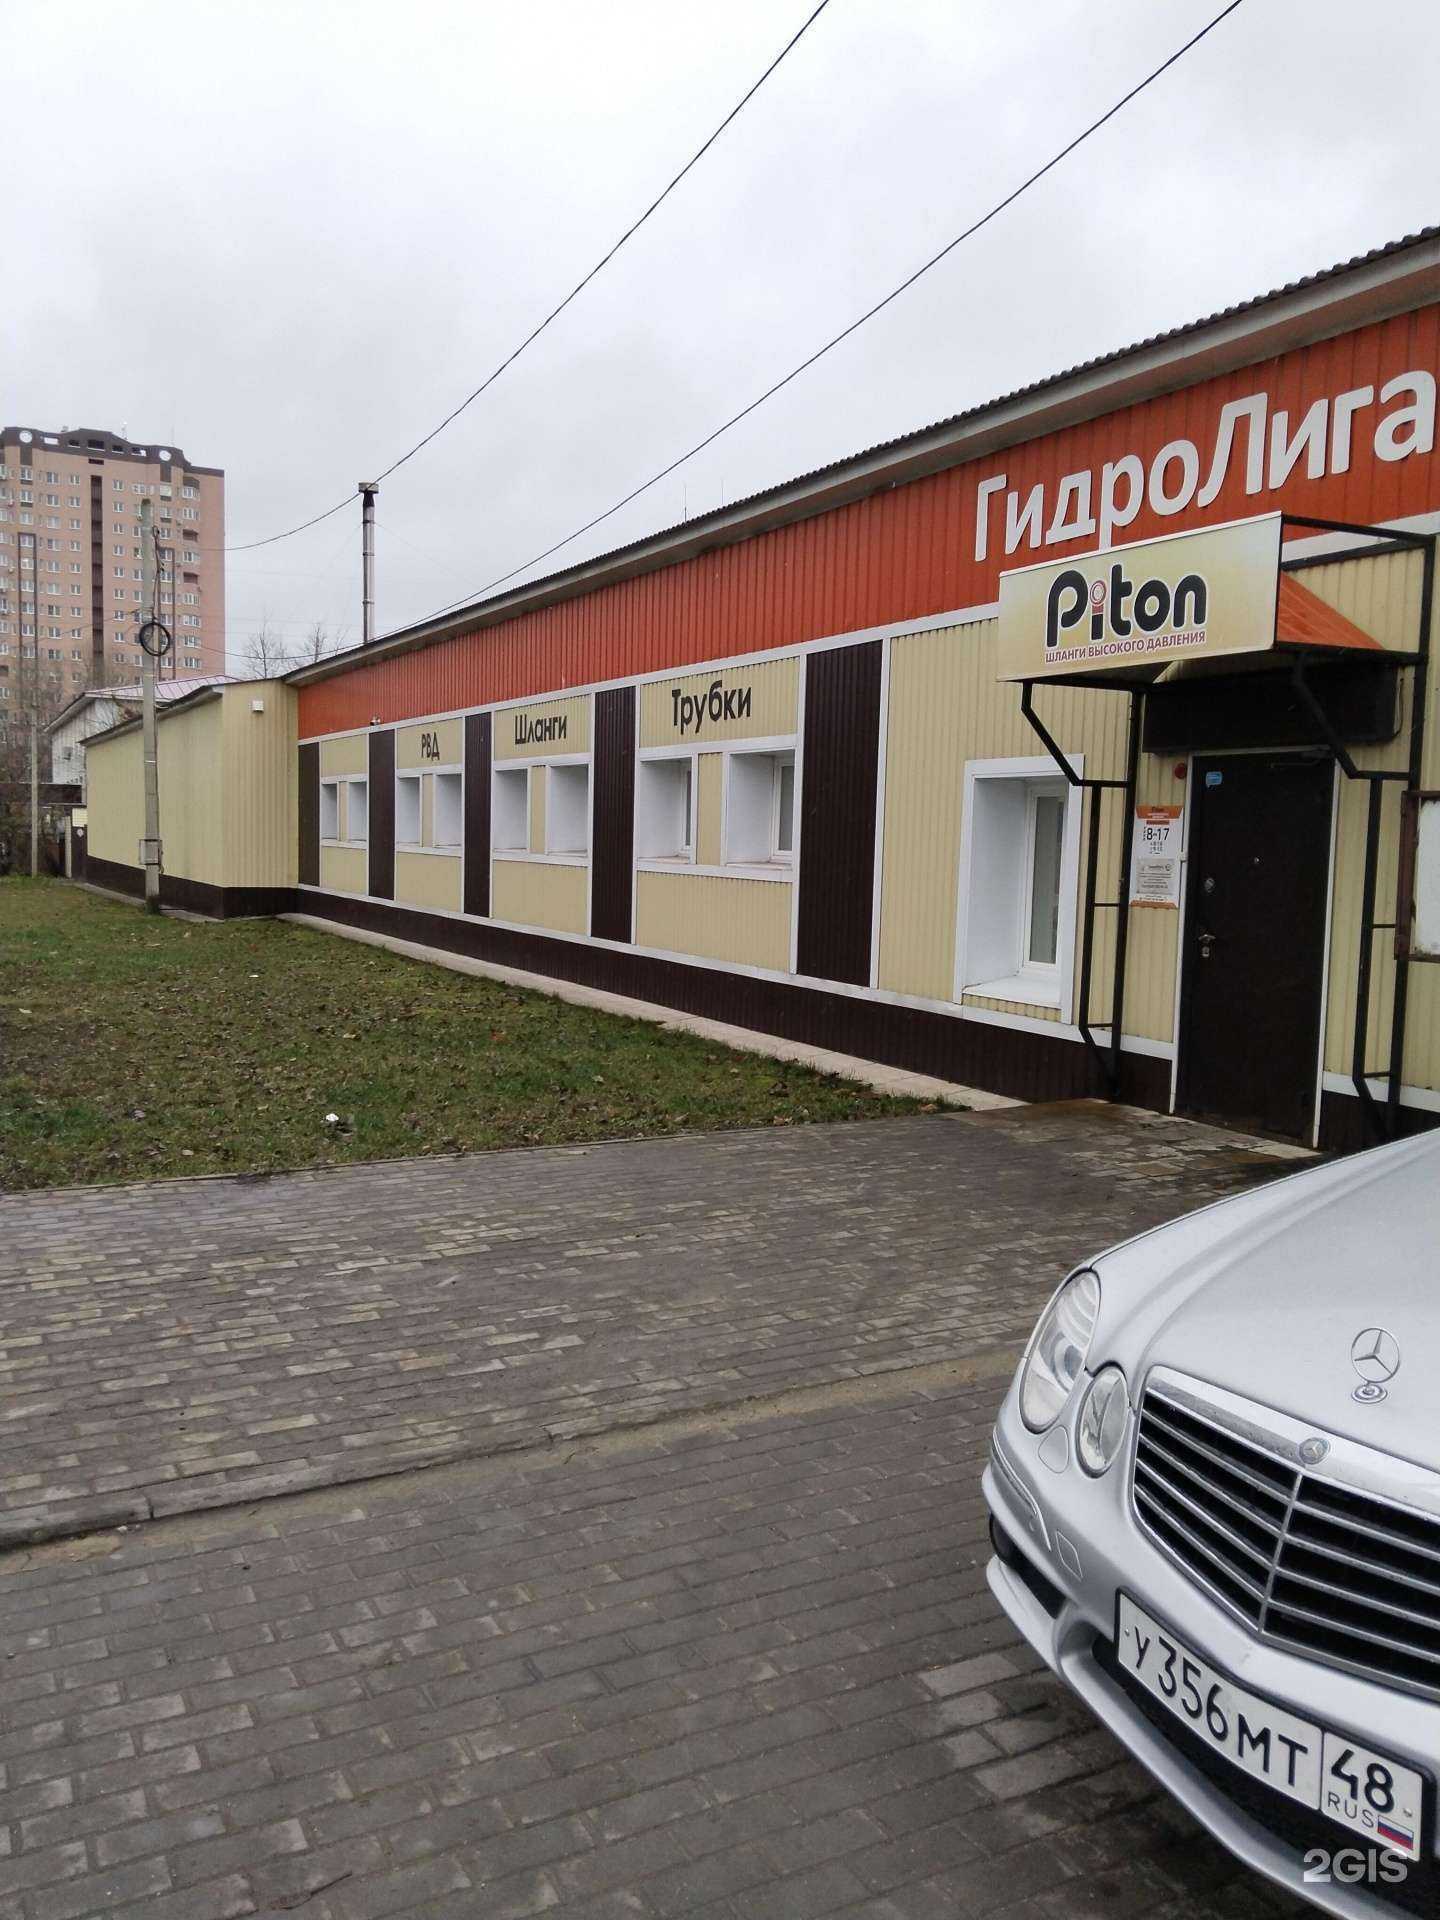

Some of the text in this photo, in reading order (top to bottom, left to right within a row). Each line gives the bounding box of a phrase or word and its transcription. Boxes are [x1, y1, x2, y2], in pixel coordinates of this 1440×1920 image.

[974, 370, 1437, 562] ГидроЛига
[1046, 563, 1208, 648] Piton
[1045, 631, 1206, 663] ШЛАНГИ ВЫСОКОГО ДАВЛЕНИЯ
[514, 714, 568, 745] Шланги
[672, 680, 752, 735] Трубки
[421, 732, 440, 760] РВД
[1134, 1626, 1308, 1787] У356МТ
[1331, 1748, 1395, 1814] 48
[1327, 1793, 1376, 1829] RUS
